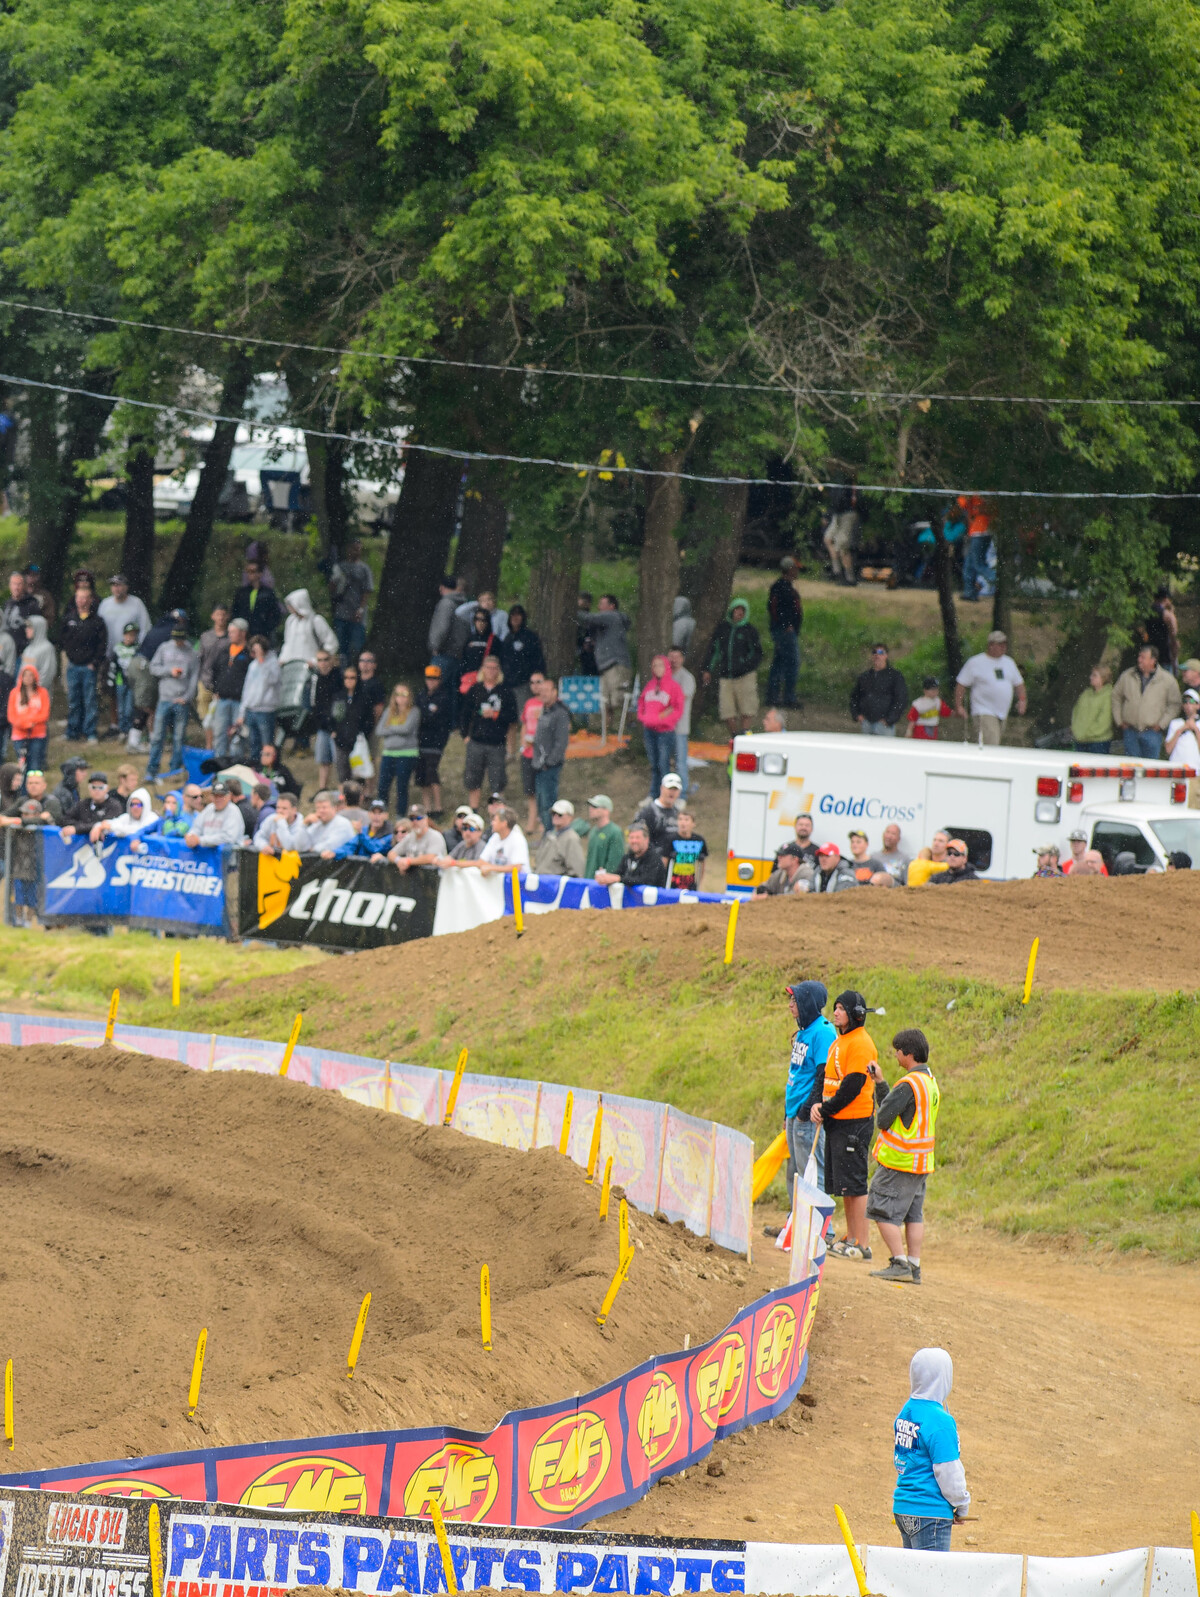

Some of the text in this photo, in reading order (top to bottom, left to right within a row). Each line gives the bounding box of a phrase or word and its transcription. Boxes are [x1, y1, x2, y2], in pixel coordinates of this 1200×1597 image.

[819, 793, 915, 822] GoldCross
[895, 1432, 913, 1449] REW
[896, 1418, 920, 1439] RACK
[528, 1419, 605, 1494] FMF
[403, 1453, 495, 1517] FMF
[51, 1505, 124, 1545] LUCAS OIL
[168, 1522, 745, 1597] PARTS PARTS PARTS
